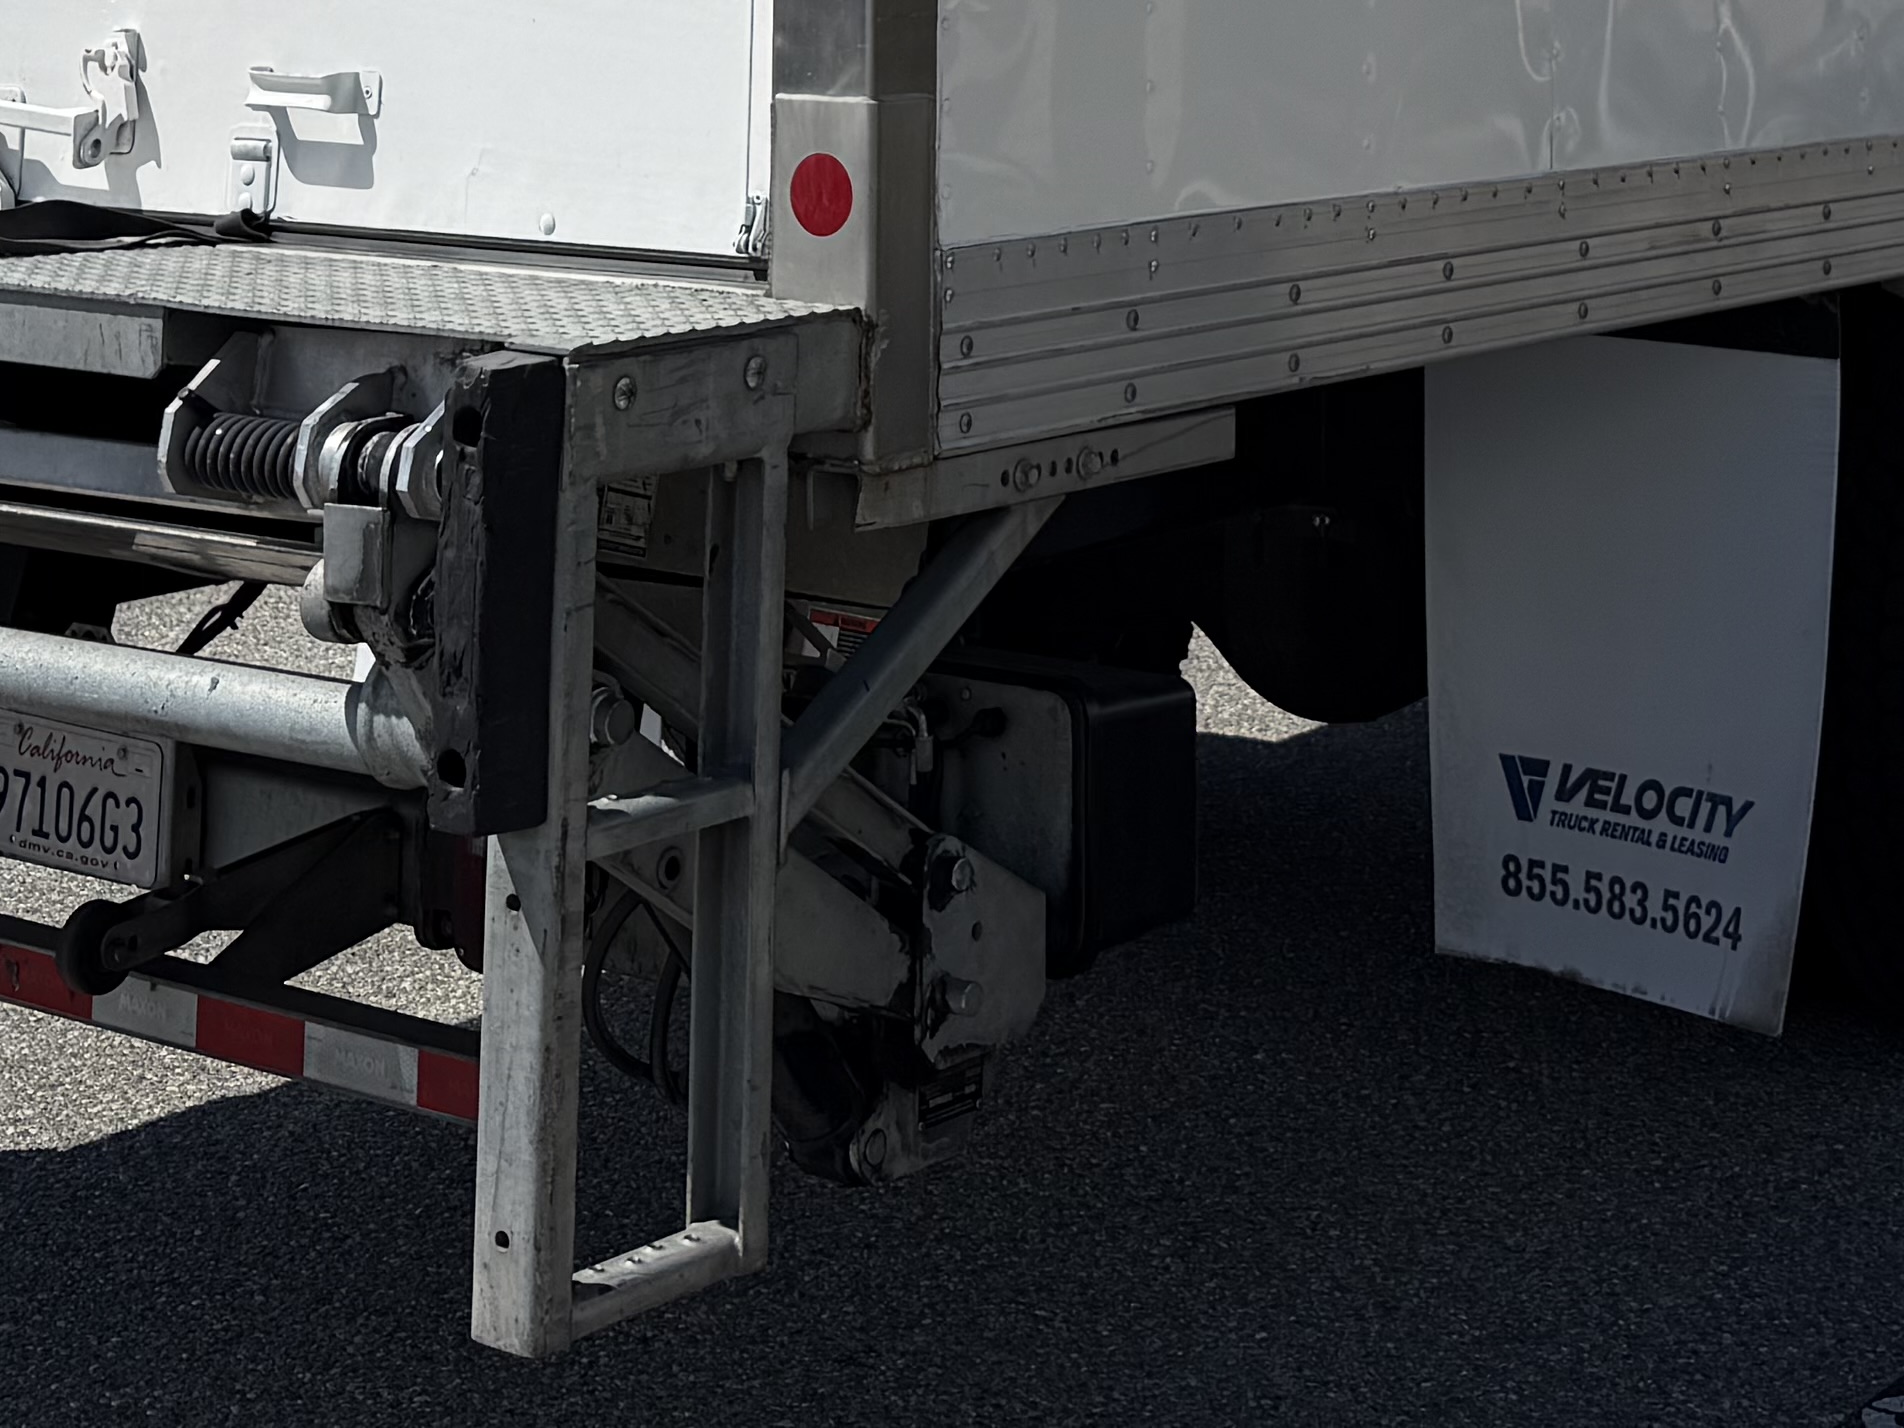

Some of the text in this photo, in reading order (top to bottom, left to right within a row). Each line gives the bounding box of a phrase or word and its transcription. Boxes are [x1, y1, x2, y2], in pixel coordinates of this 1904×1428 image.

[18, 726, 128, 777] California
[1553, 762, 1756, 838] VELOCITY
[18, 838, 110, 869] dmv.ca.gov
[1549, 808, 1730, 865] TRUCK RENTAL & LEASING
[1500, 852, 1743, 951] 855.583.5624
